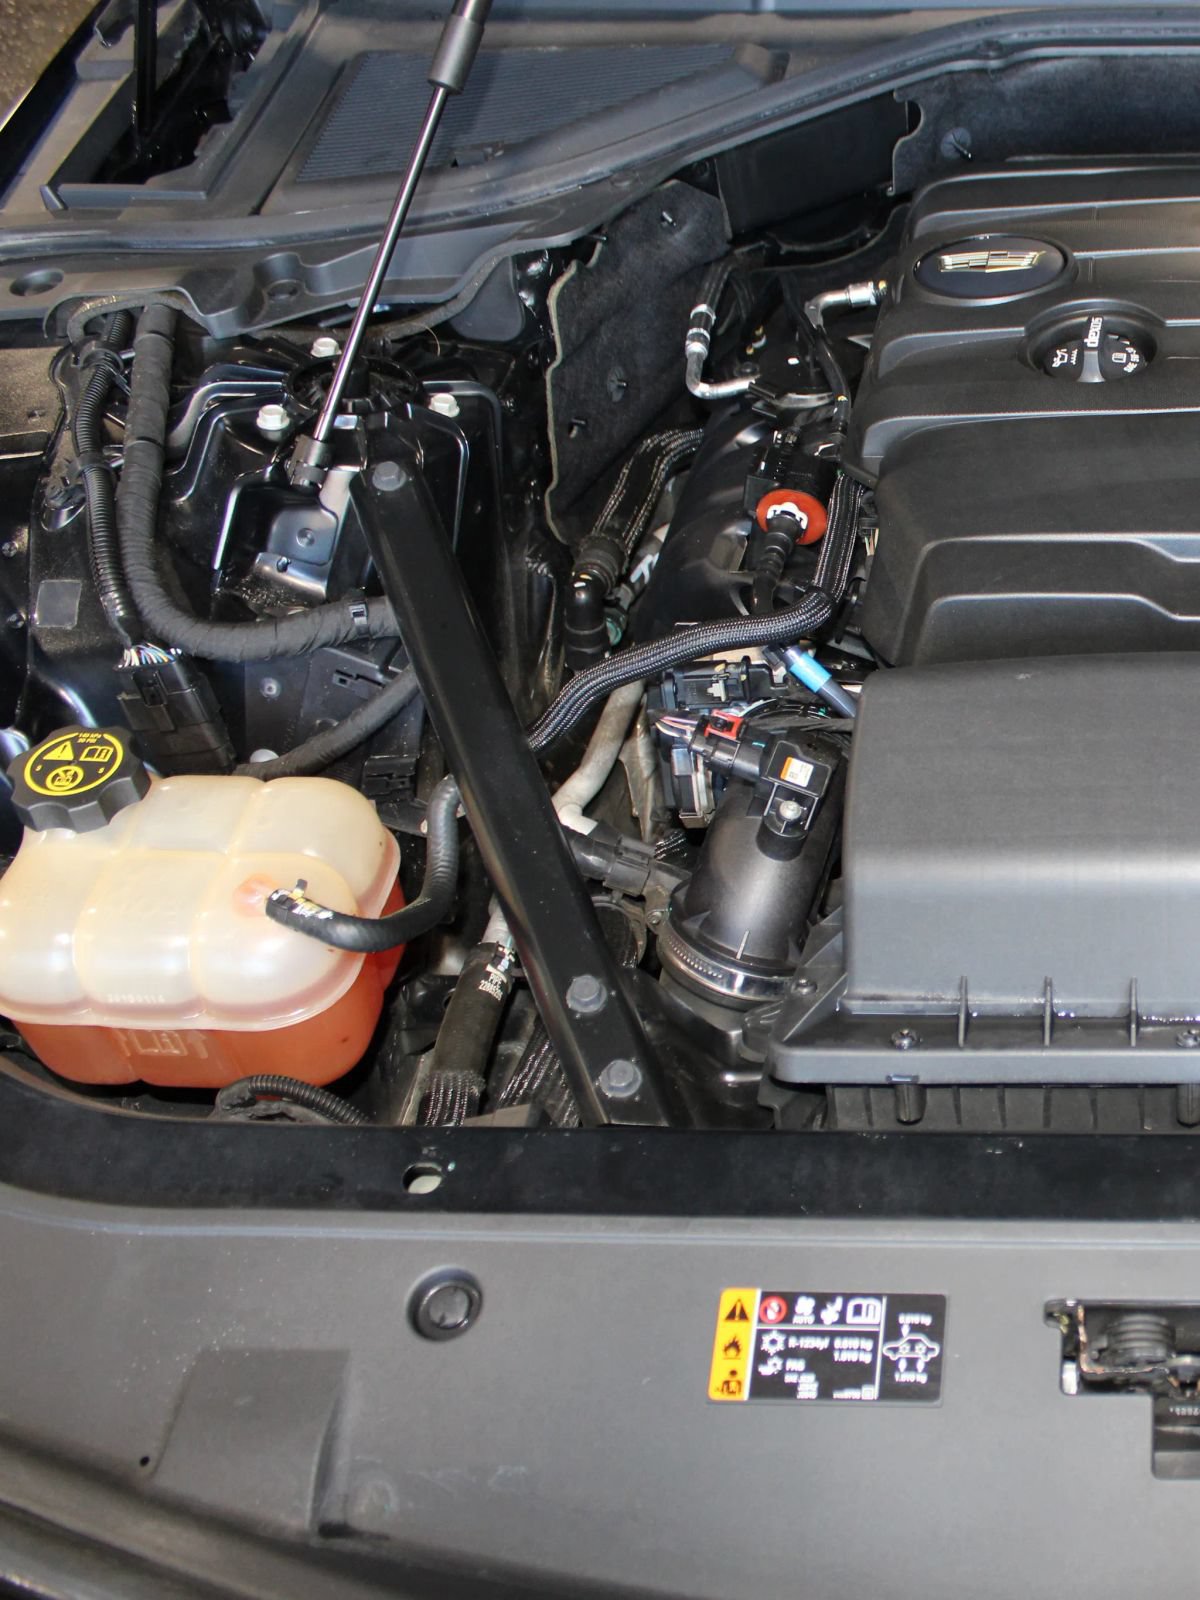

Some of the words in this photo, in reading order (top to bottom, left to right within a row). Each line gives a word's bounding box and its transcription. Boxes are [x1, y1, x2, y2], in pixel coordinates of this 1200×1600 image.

[1084, 317, 1103, 347] dexos
[792, 1314, 815, 1325] AUTO
[920, 1314, 932, 1326] kg
[860, 1338, 873, 1351] kg
[859, 1351, 872, 1364] kg
